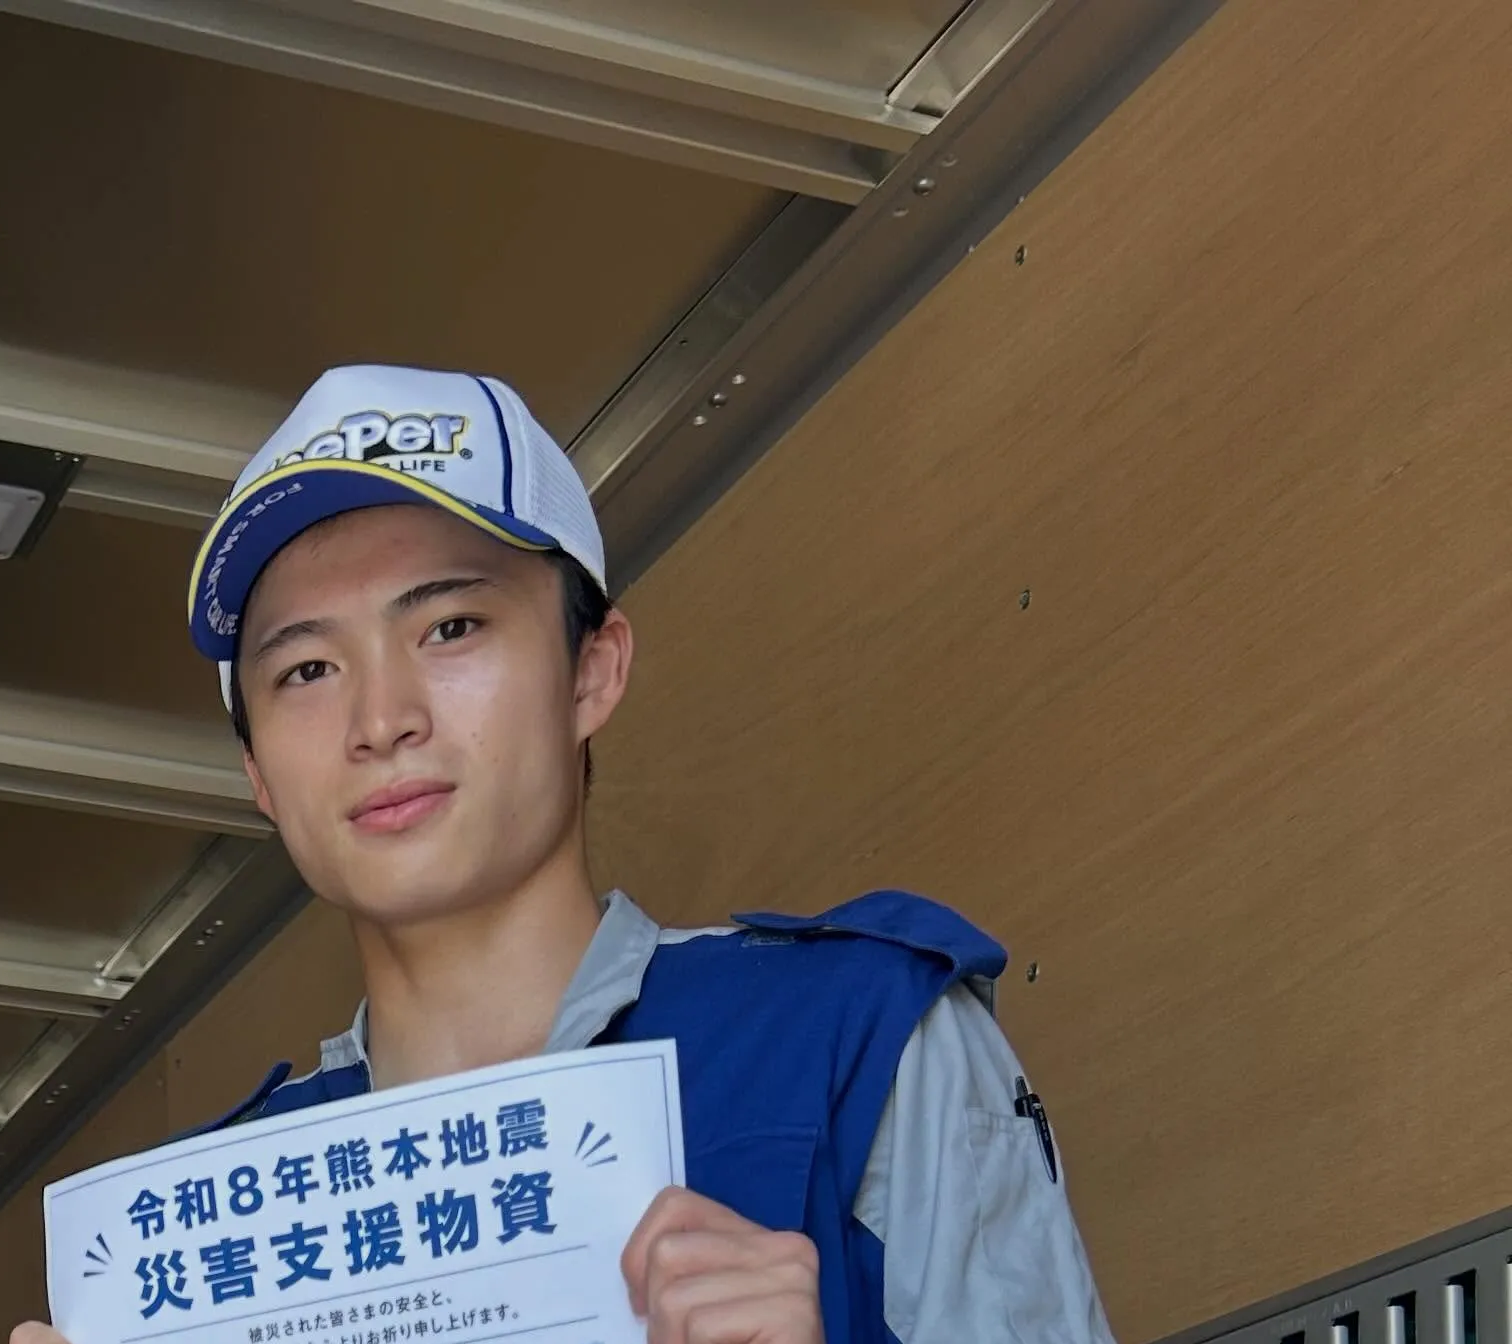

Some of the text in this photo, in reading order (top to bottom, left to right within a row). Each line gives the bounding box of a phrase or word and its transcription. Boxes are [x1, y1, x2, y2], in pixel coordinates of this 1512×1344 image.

[399, 460, 447, 472] LIFE
[245, 482, 304, 518] FOR
[127, 1098, 549, 1240] 令和8年熊本地震
[135, 1171, 557, 1320] 災害支援物資
[248, 1290, 453, 1344] 被災された皆さまの安全と、
